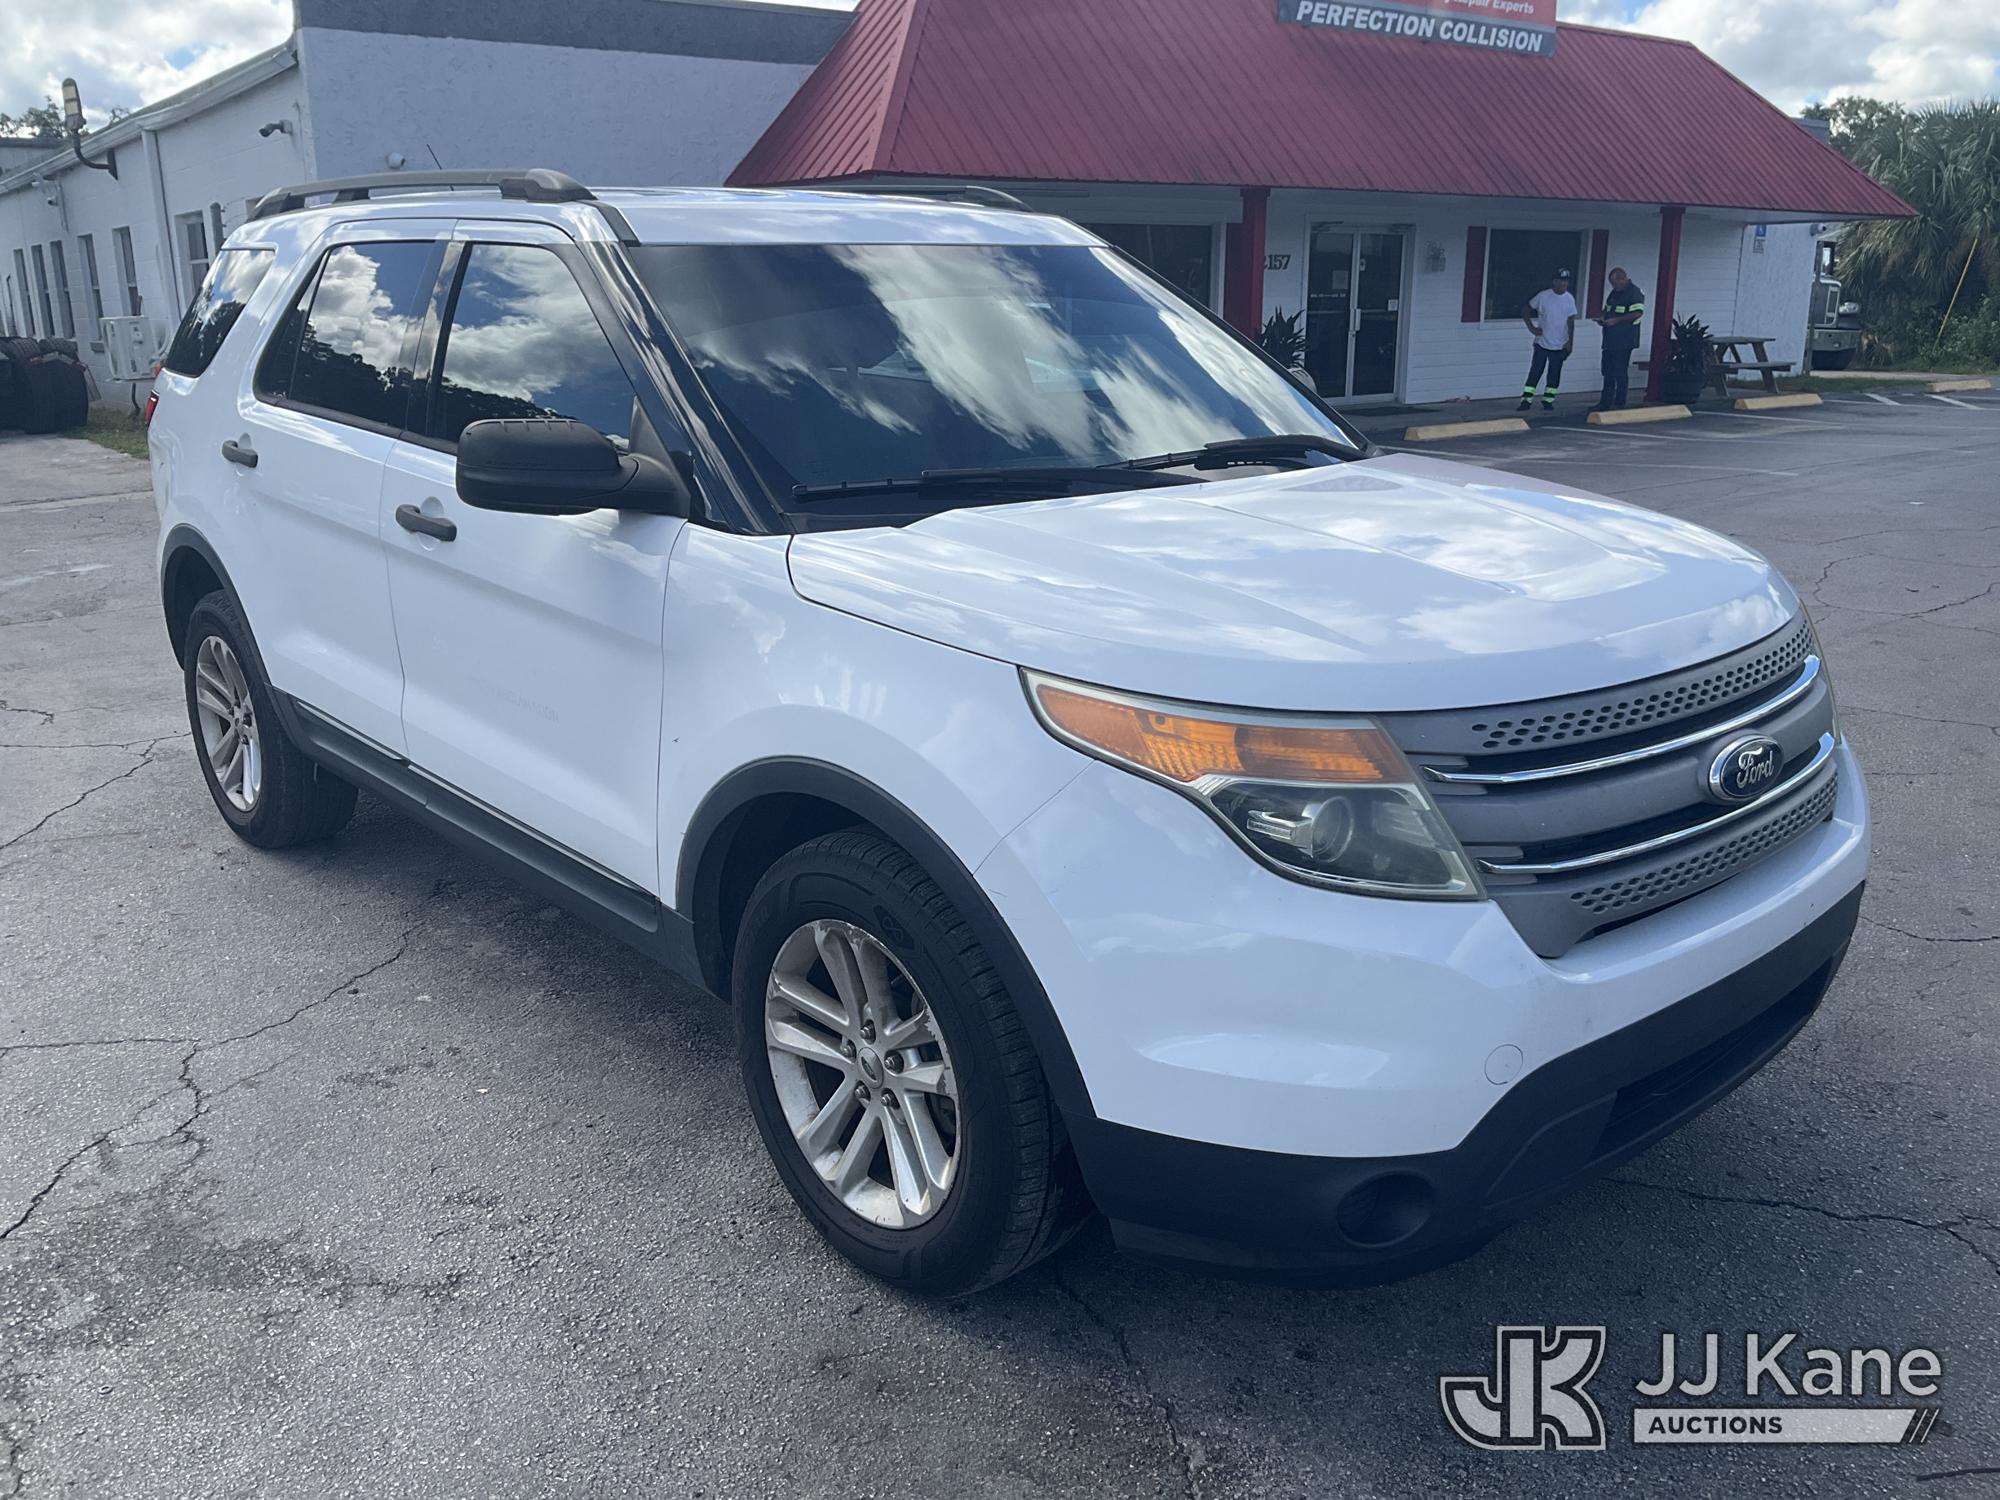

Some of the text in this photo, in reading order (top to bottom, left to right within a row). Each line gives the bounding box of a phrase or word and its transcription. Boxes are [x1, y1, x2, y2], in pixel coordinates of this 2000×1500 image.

[1296, 0, 1542, 52] PERFECTION COLLISION
[1493, 0, 1534, 14] Experts
[1736, 747, 1775, 789] Ford
